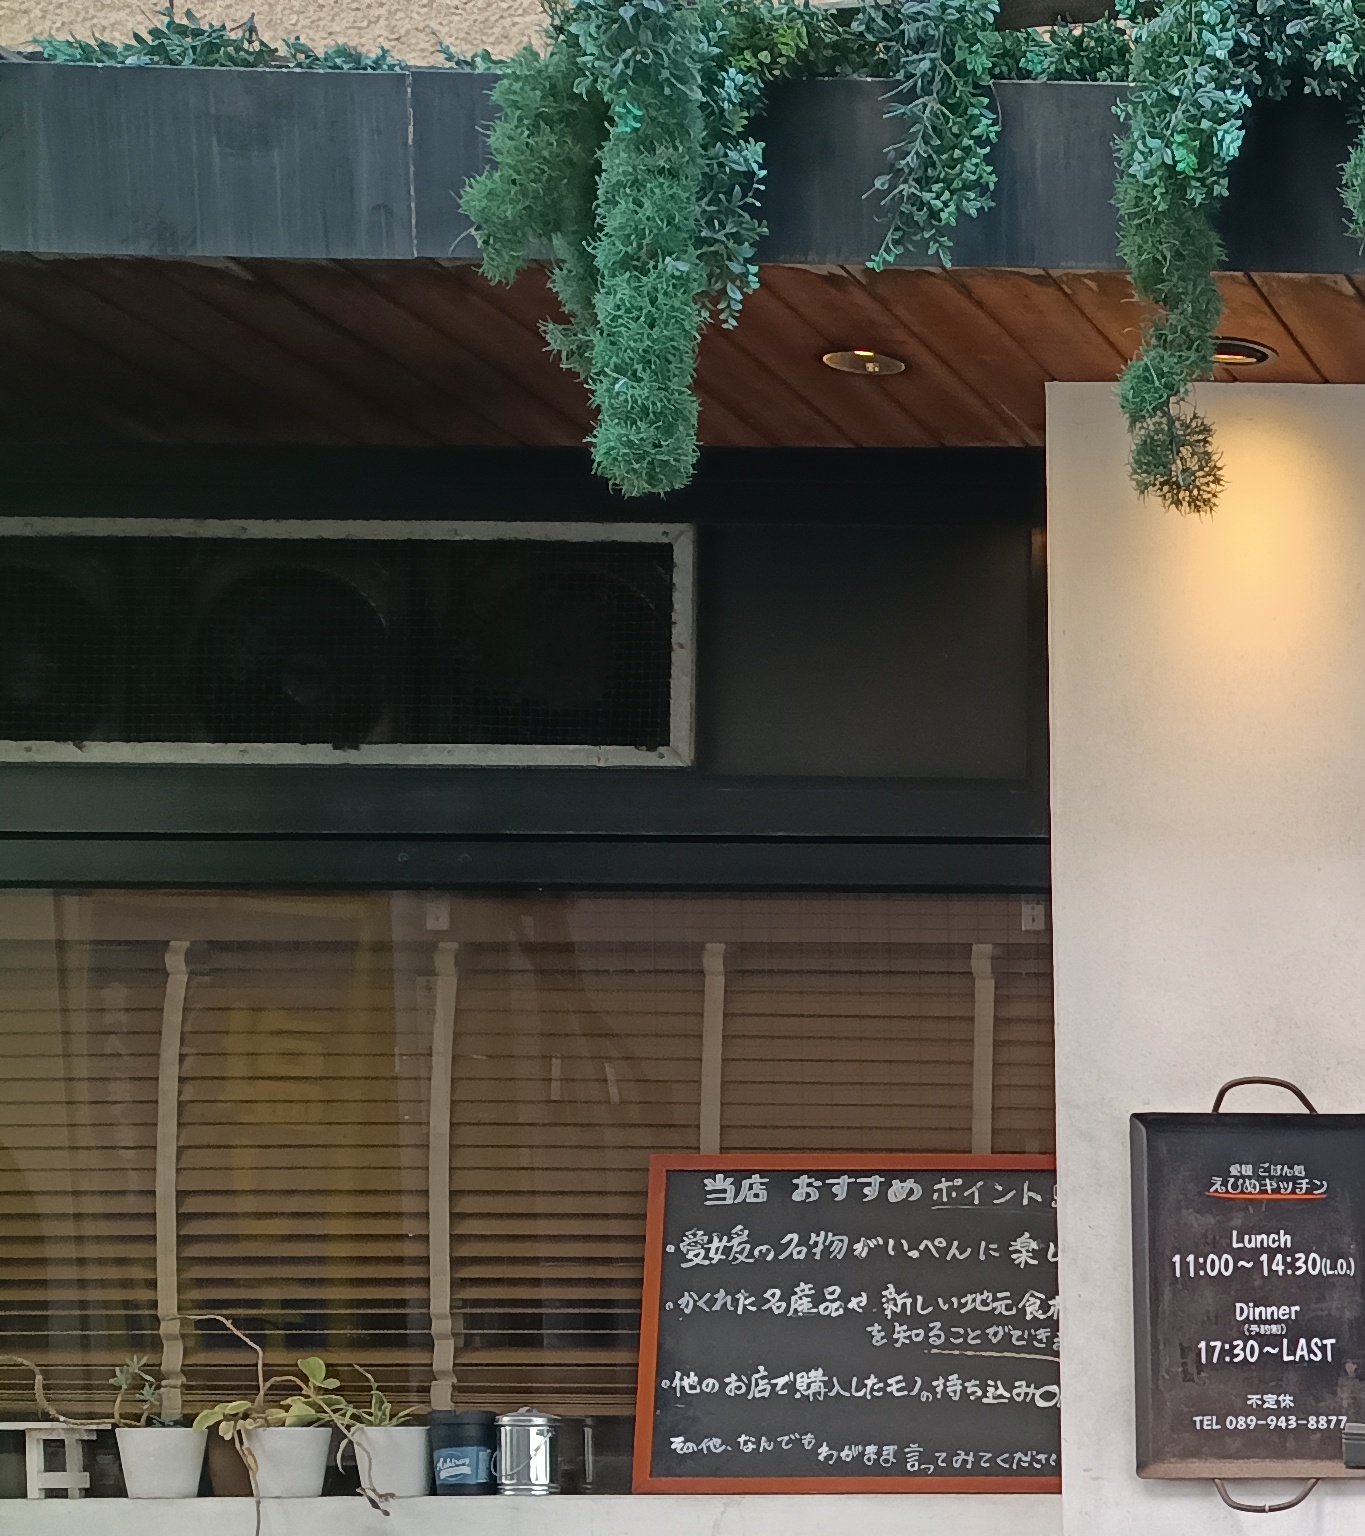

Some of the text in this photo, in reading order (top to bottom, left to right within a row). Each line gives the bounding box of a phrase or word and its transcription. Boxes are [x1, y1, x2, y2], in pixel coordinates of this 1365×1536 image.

[703, 1173, 771, 1206] 当店
[1209, 1176, 1328, 1195] えひめキッチン
[1232, 1230, 1292, 1249] Lunch
[1235, 1302, 1301, 1322] Dinner
[671, 1366, 1061, 1409] 他のお店で購入したモノの持ち込みO
[1246, 1393, 1295, 1410] 不定休
[1192, 1415, 1348, 1431] TEL 089-943-8877
